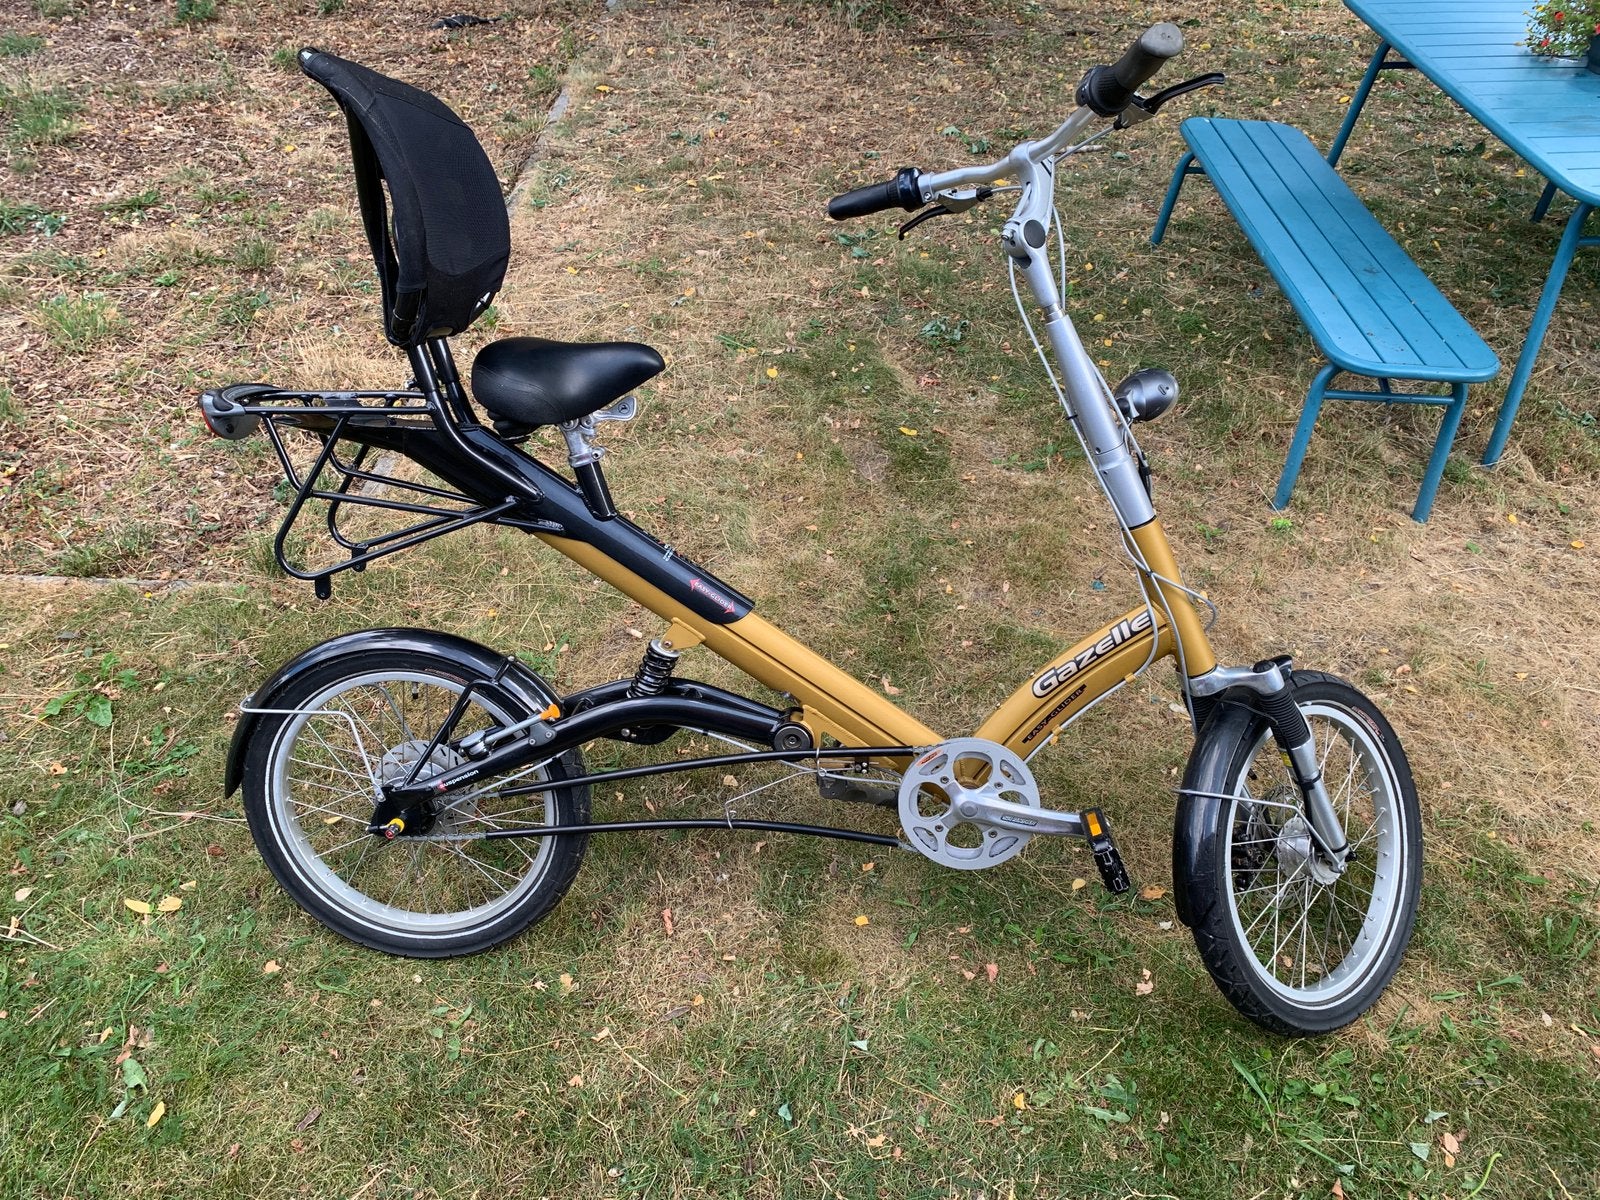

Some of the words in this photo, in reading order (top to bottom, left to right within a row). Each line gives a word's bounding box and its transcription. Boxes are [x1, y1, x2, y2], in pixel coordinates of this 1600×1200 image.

[693, 581, 732, 610] EASY-GLIDER
[1032, 609, 1153, 698] Gazelle
[1027, 688, 1084, 741] EASY-GLIDER
